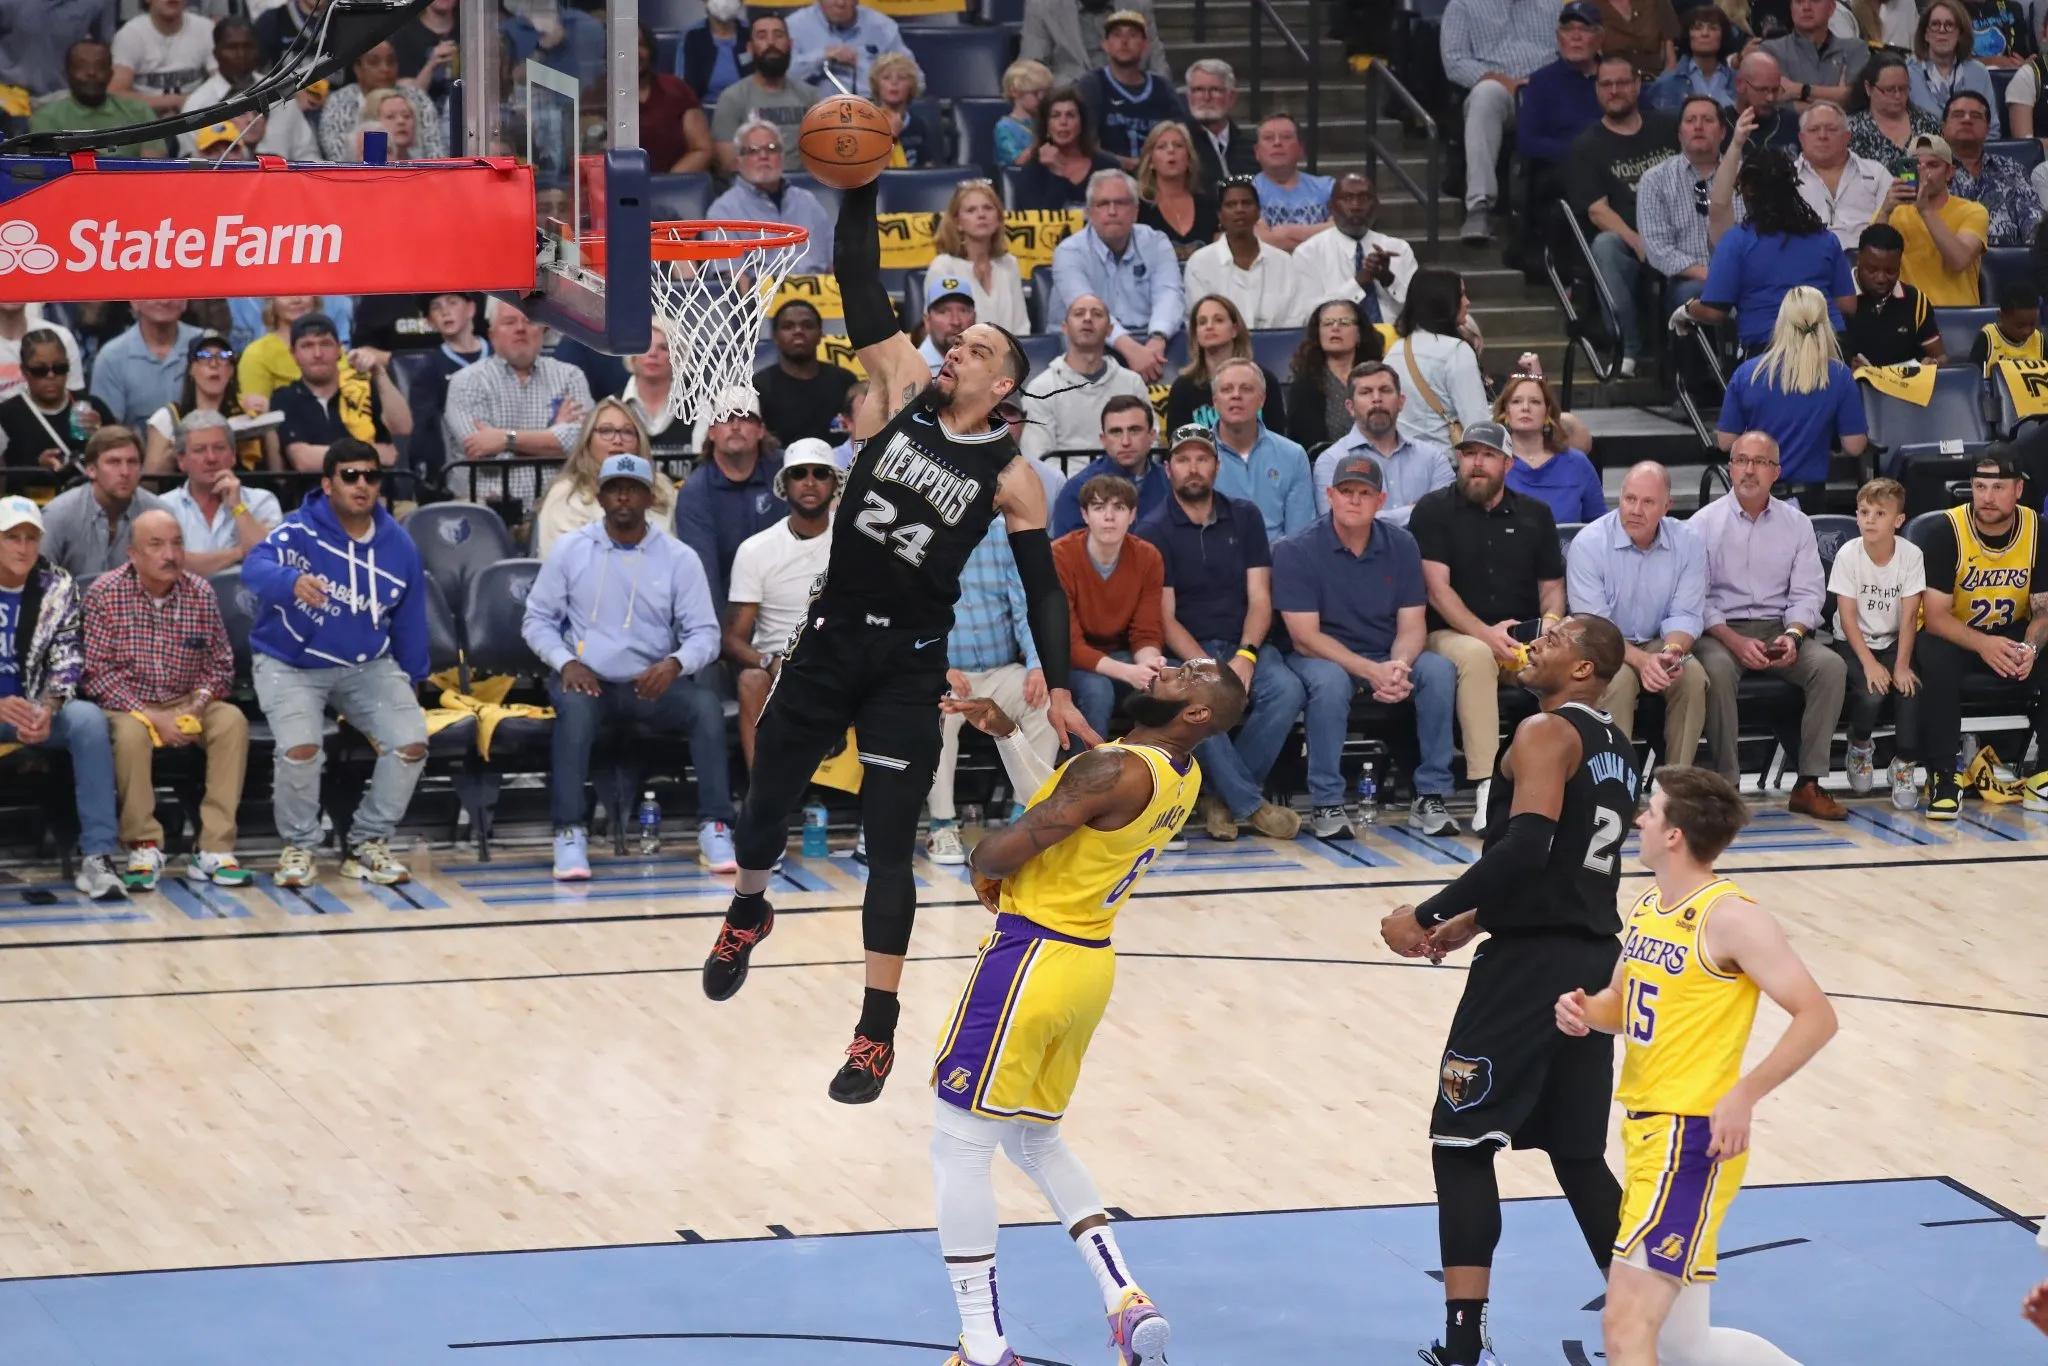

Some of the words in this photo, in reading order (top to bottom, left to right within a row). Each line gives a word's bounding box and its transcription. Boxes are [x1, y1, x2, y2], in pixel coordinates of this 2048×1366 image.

[872, 430, 982, 527] MEMPHIS
[853, 489, 936, 568] 24
[1868, 600, 1891, 612] BOY
[1959, 566, 2029, 592] LAKERS
[1967, 598, 2016, 630] 23
[1148, 805, 1186, 834] JAMES
[1582, 804, 1623, 876] 2
[1103, 847, 1156, 908] 6
[1624, 925, 1689, 975] LAKERS
[1624, 977, 1660, 1045] 15
